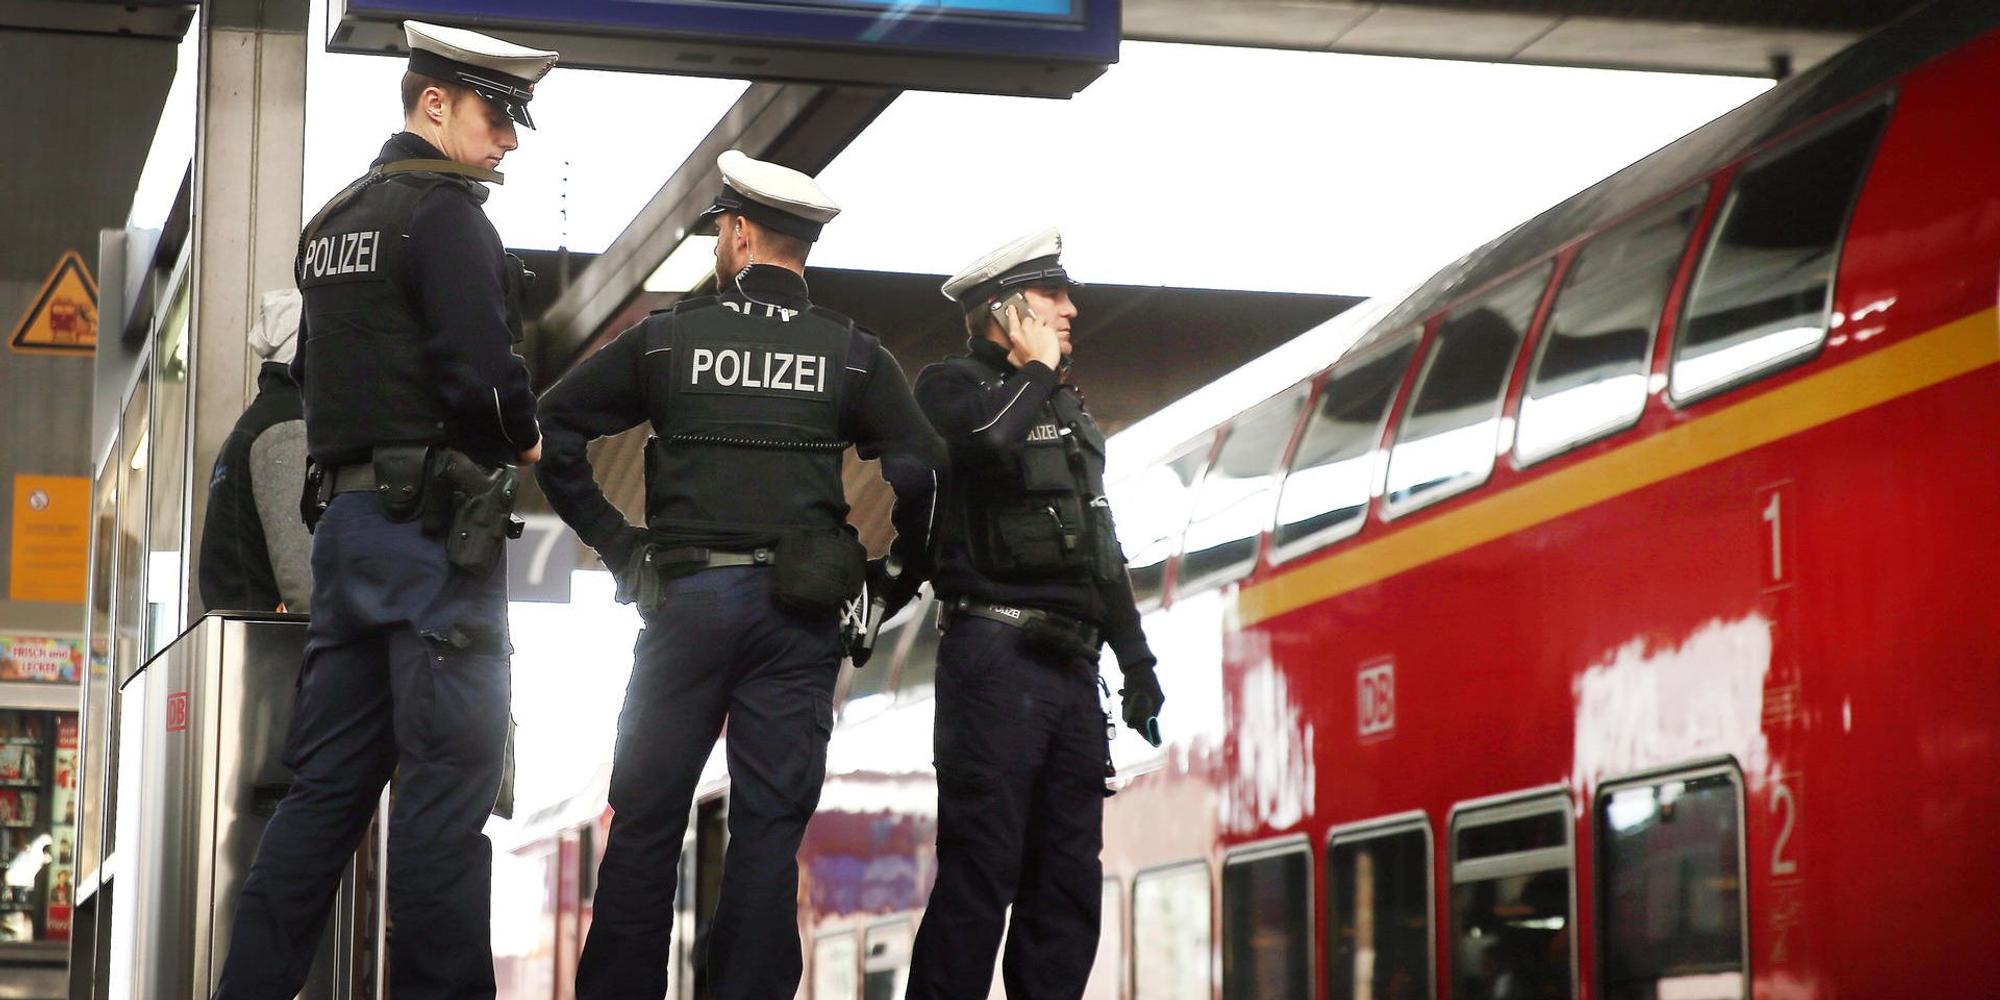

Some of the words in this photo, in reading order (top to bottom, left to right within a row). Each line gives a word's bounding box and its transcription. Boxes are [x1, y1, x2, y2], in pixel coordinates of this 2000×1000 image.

[303, 231, 380, 280] POLIZEI
[691, 348, 826, 393] POLIZEI
[1026, 424, 1059, 441] LIZEI
[521, 516, 566, 585] 7
[1763, 493, 1782, 580] 1
[989, 606, 1021, 619] OLIZEI
[168, 697, 187, 726] DB
[1360, 668, 1394, 730] DB
[1770, 784, 1796, 875] 2
